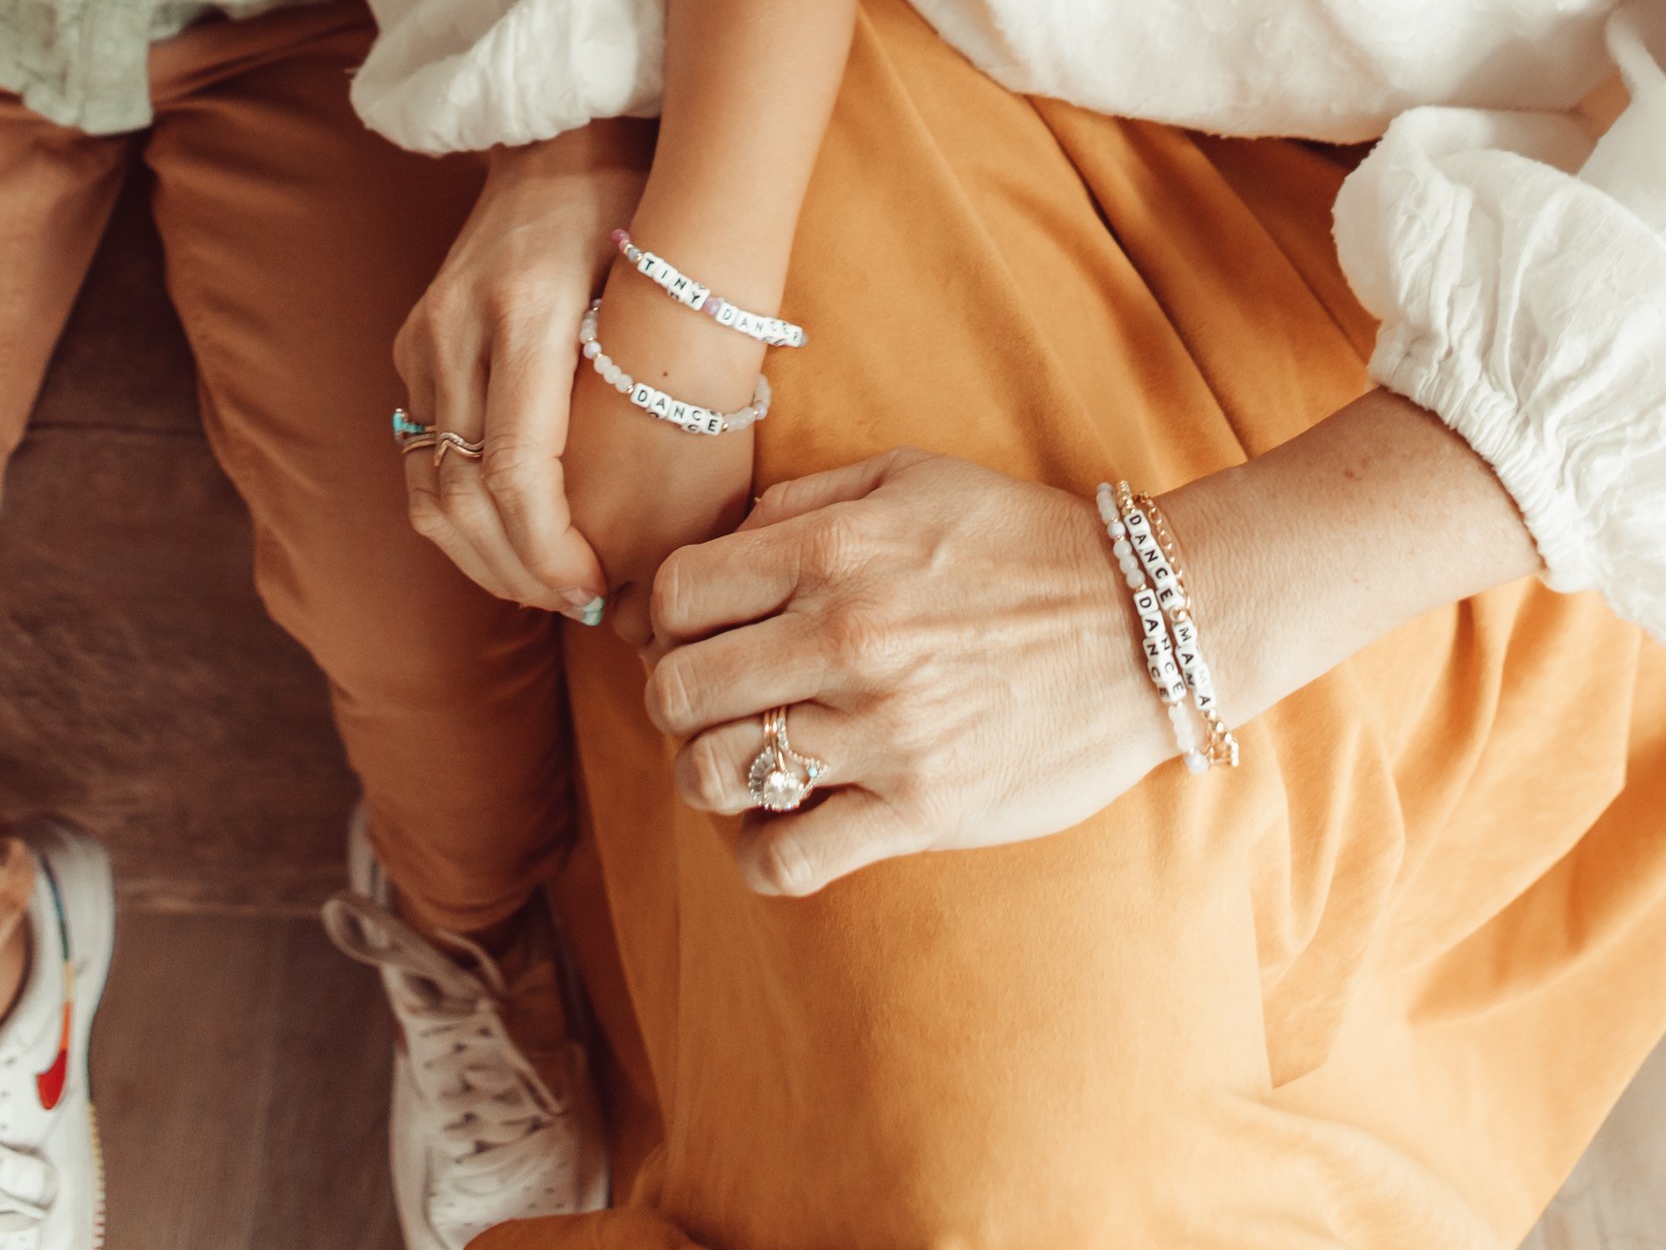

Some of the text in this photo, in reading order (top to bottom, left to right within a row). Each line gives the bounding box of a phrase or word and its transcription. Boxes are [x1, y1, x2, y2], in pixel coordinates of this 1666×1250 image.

[643, 257, 700, 304] TINY
[636, 389, 719, 433] DANCE
[1128, 513, 1212, 707] DANCE MAMA
[1138, 596, 1184, 699] DANCE
